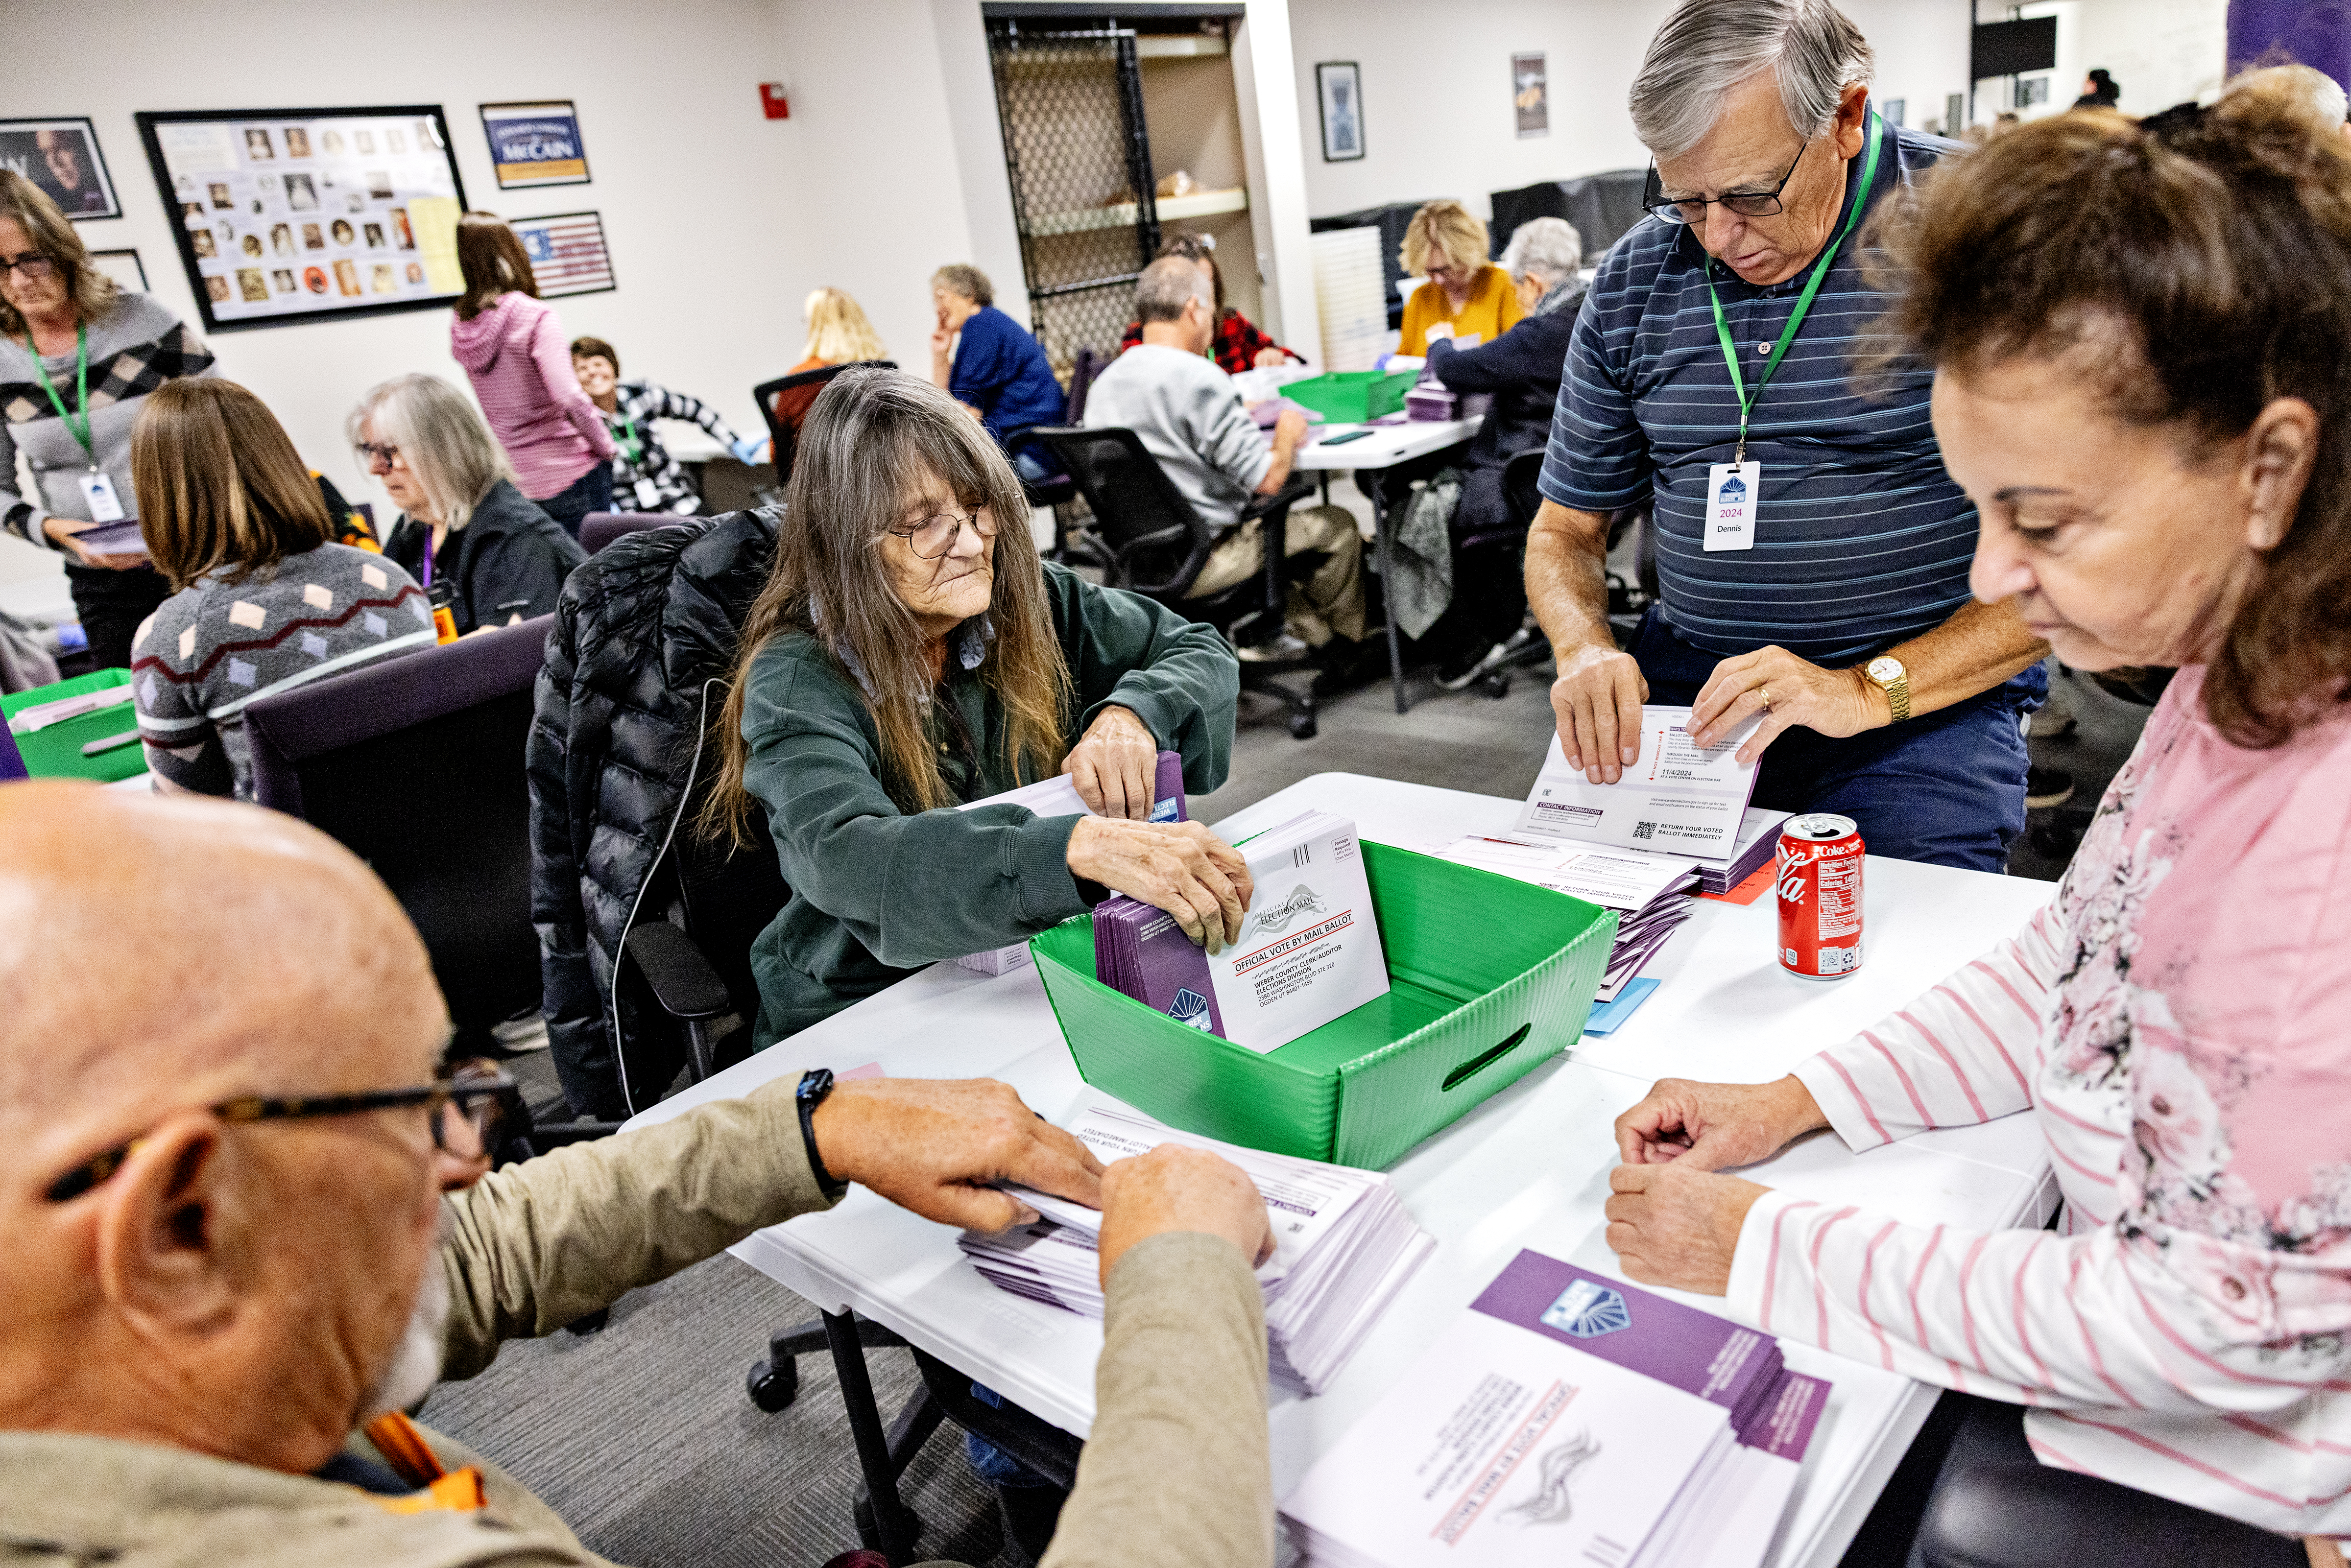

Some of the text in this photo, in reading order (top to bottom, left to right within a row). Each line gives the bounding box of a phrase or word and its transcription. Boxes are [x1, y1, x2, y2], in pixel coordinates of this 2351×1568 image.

[1720, 509, 1742, 518] 2024
[1149, 808, 1171, 821] WEBER
[1563, 806, 1601, 814] INFORMATION
[1335, 837, 1349, 846] Postage
[1335, 842, 1351, 852] Required
[1344, 851, 1354, 859] Stamp
[1820, 845, 1845, 856] Coke
[1844, 874, 1855, 883] 140
[1587, 892, 1633, 901] IMMEDIATELY
[1255, 902, 1285, 918] OFFICIAL
[1261, 896, 1315, 925] ELECTION MAIL
[1140, 923, 1152, 931] WEBER
[1153, 915, 1168, 925] COUNTY
[1149, 919, 1174, 932] WASHINGTON
[1141, 932, 1154, 942] OGDEN
[1235, 914, 1353, 973] OFFICIAL VOTE BY MAIL BALLOT
[1254, 944, 1343, 989] WEBER COUNTY CLERK/AUDITOR
[1256, 966, 1312, 996] ELECTIONS DIVISION
[1258, 993, 1271, 1002] 2380
[1271, 977, 1304, 996] WASHINGTON
[1304, 971, 1317, 980] BLVD
[1326, 962, 1335, 971] 320
[1260, 979, 1313, 1008] OGDEN UT 84401-1456
[1185, 1016, 1202, 1027] EBER
[1078, 1134, 1119, 1150] YOUR VOTED
[1082, 1128, 1151, 1150] ALLOT IMMEDIATELY
